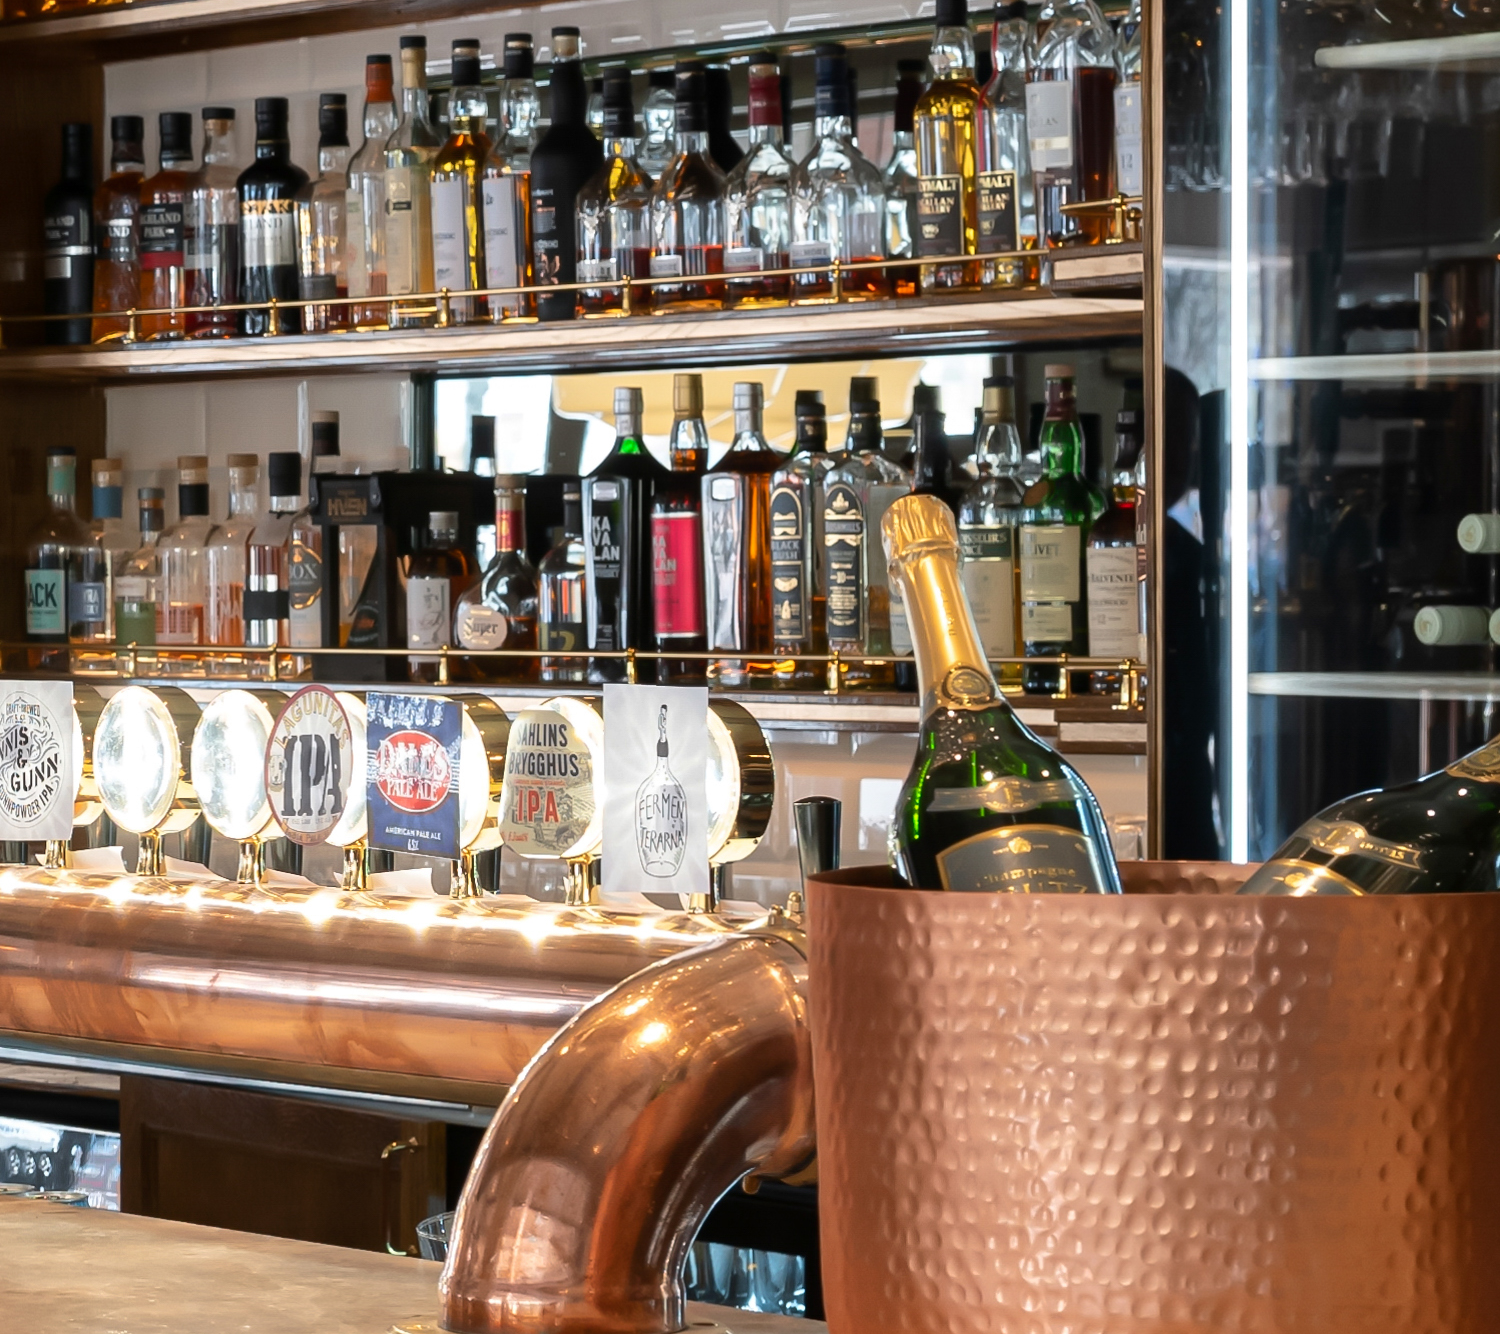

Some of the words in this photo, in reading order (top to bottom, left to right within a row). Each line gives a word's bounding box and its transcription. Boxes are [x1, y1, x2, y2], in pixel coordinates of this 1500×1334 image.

[592, 516, 611, 532] KA
[592, 531, 612, 547] VA
[771, 539, 800, 550] BLACK
[593, 546, 620, 561] LAN
[274, 691, 350, 750] LAGUNITAS
[516, 723, 568, 748] SAHLINS
[16, 749, 28, 769] &
[508, 751, 580, 777] BRYGGHUS
[10, 753, 60, 793] GUNN
[281, 733, 343, 817] IPA
[386, 780, 414, 799] PALE
[416, 781, 439, 802] ALE
[516, 788, 561, 824] IPA
[638, 791, 686, 821] FERMEN
[639, 826, 685, 854] TERARNA
